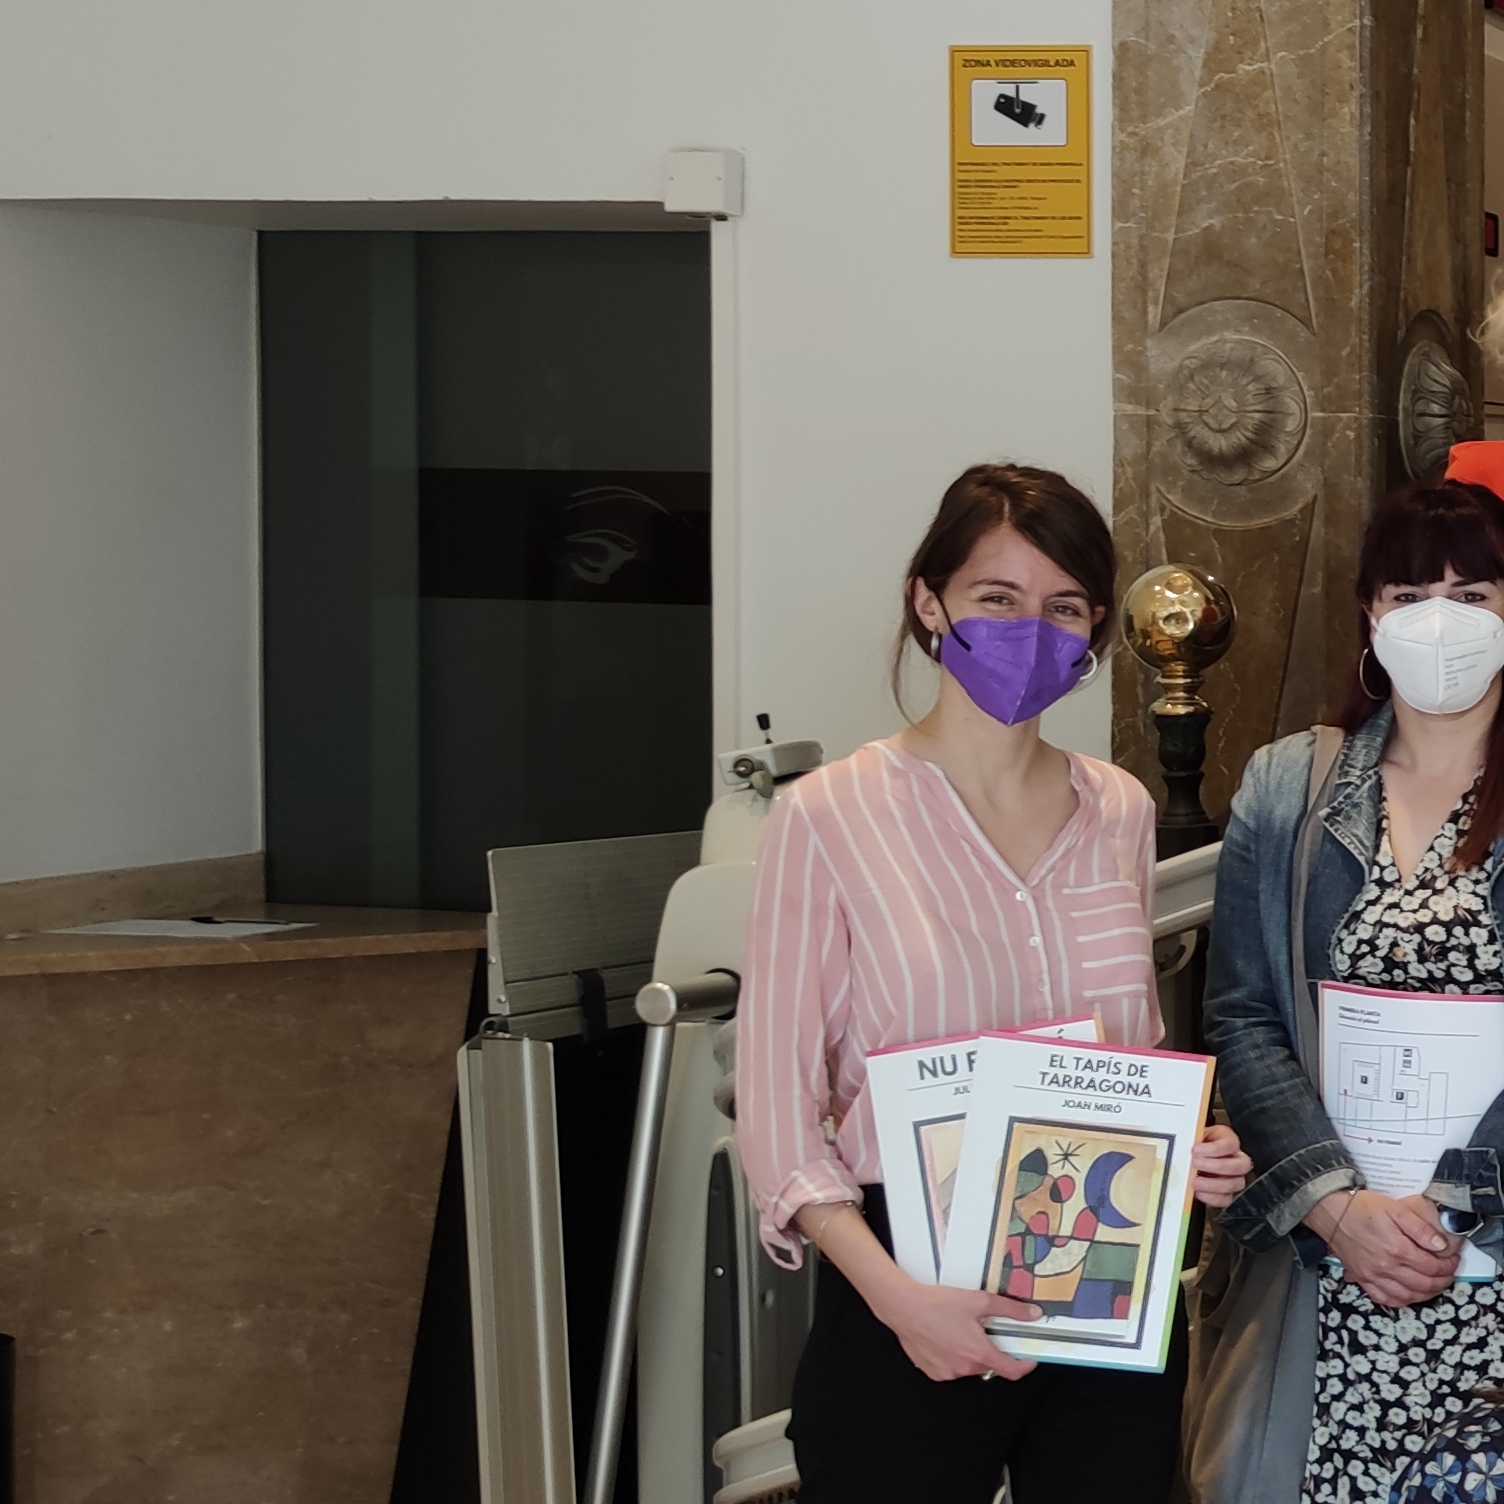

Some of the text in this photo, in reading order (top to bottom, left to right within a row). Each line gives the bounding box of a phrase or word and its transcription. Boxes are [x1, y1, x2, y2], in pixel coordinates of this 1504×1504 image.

[962, 59, 1076, 68] ZONA VIDEOVIGILADA
[917, 1053, 958, 1080] NU
[1049, 1053, 1149, 1078] EL TAPÍS DE
[1039, 1070, 1152, 1098] TARRAGONA
[1061, 1099, 1122, 1114] JOAN MIRÓ
